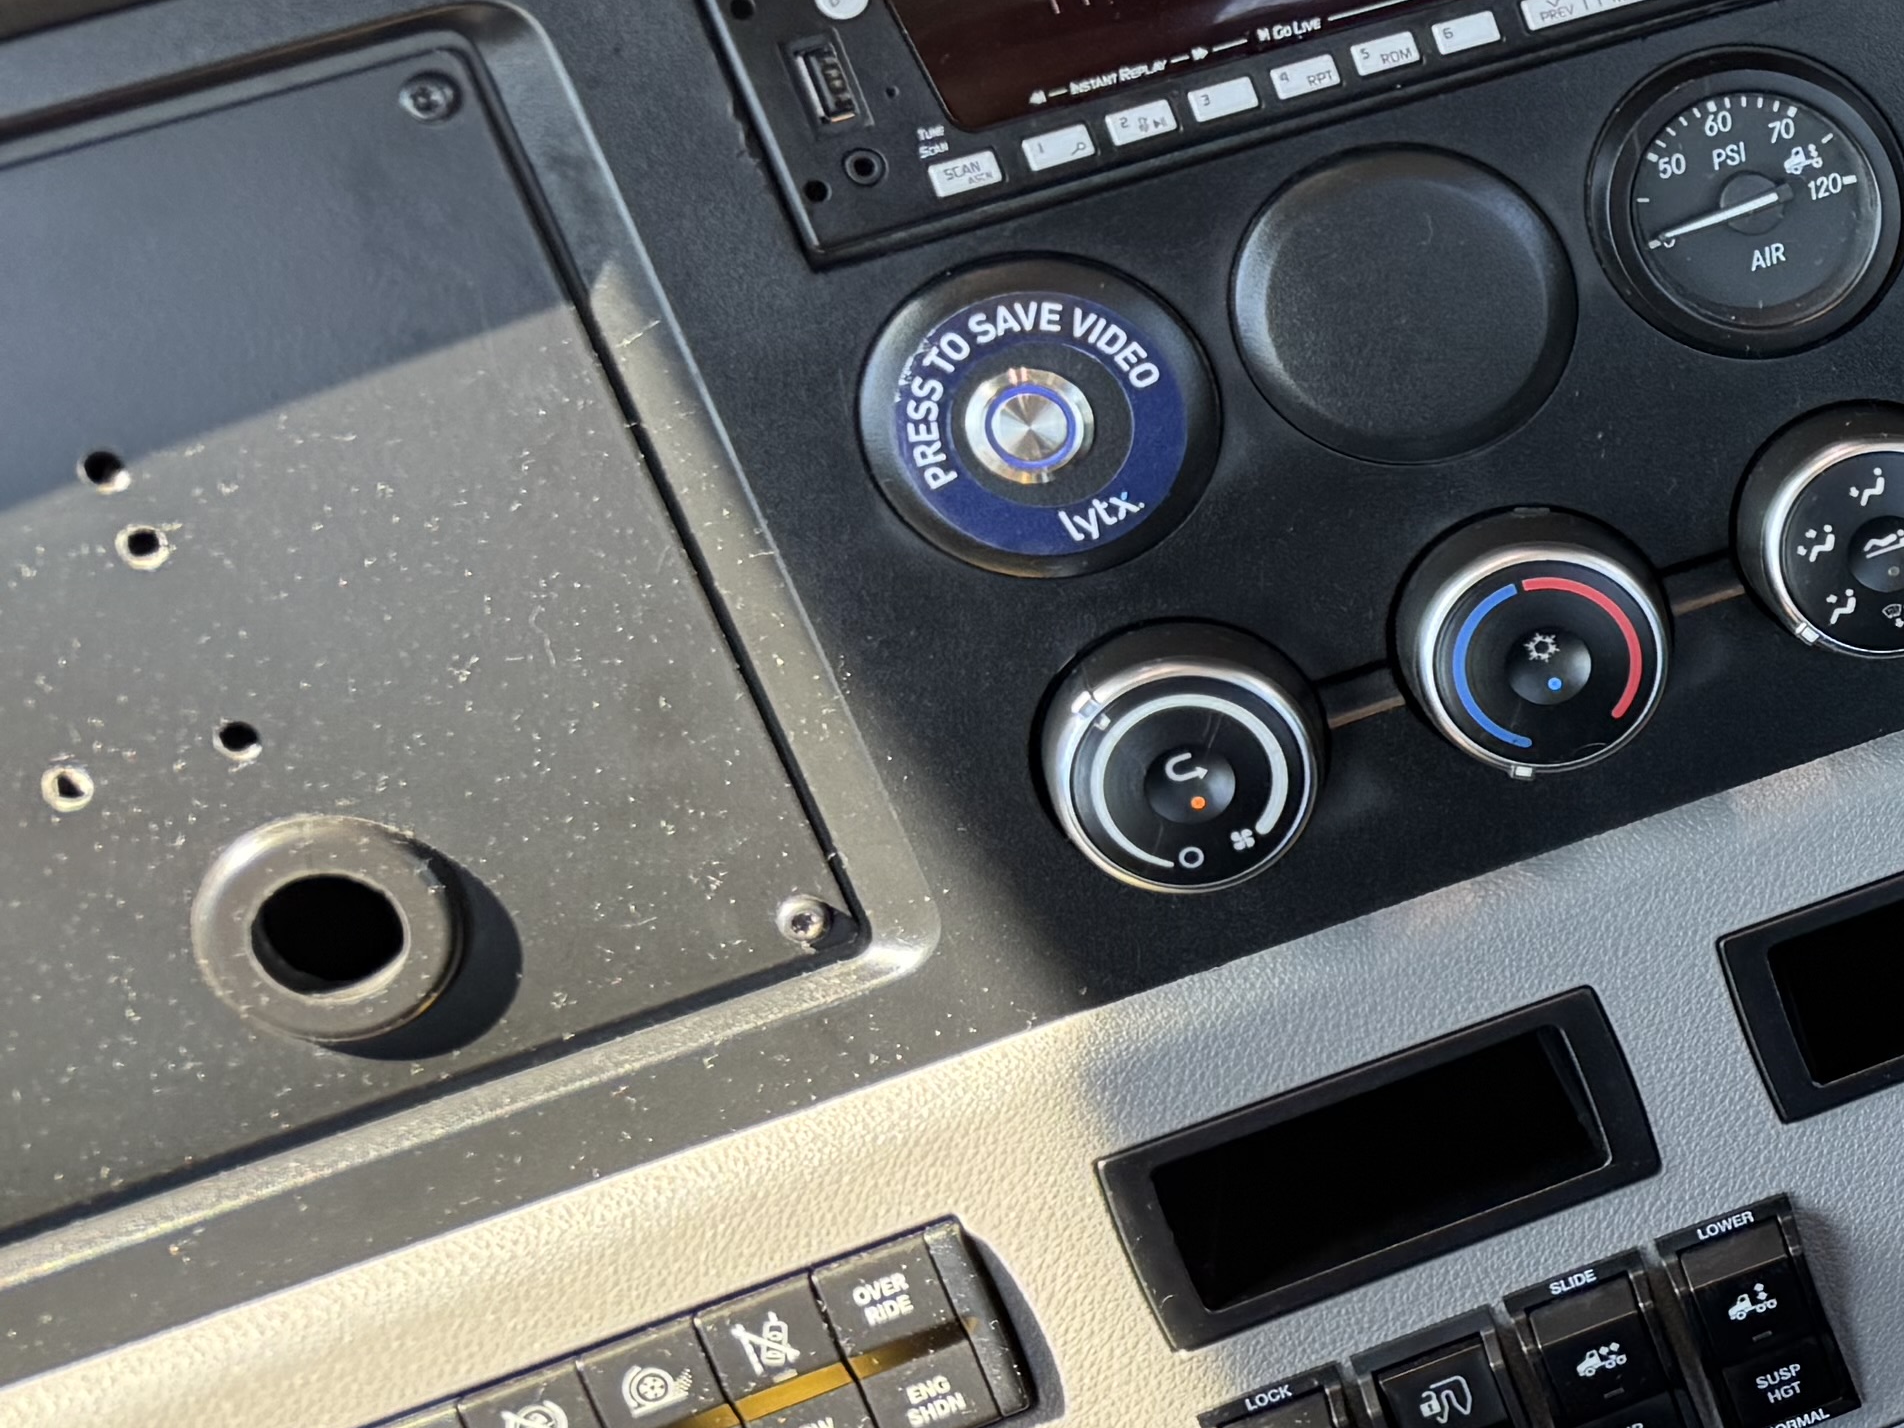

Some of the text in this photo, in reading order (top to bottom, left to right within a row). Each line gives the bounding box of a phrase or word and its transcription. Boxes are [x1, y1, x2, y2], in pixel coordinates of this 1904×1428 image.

[1539, 4, 1574, 22] PREV
[1443, 27, 1454, 40] 6
[1360, 48, 1413, 65] 5 RDM
[1307, 69, 1334, 87] RPT
[1201, 94, 1210, 106] 3
[1120, 117, 1129, 129] 2
[1704, 111, 1732, 137] 60
[1768, 118, 1795, 144] 70
[1658, 153, 1686, 179] 50
[1711, 141, 1747, 171] PSI
[943, 161, 981, 181] SCAN
[1807, 172, 1843, 201] 120
[1751, 243, 1786, 272] AIR
[907, 301, 1160, 490] PRESS TO SAVE VIDEO
[1696, 1210, 1755, 1241] LOWER
[852, 1272, 910, 1307] OVER
[1548, 1268, 1598, 1296] SLIDE
[864, 1294, 915, 1328] RIDE
[907, 1375, 952, 1405] ENG
[1755, 1363, 1802, 1393] SUSP
[1766, 1379, 1804, 1405] HGT
[907, 1392, 966, 1428] SHDN
[1243, 1382, 1293, 1413] LOCK
